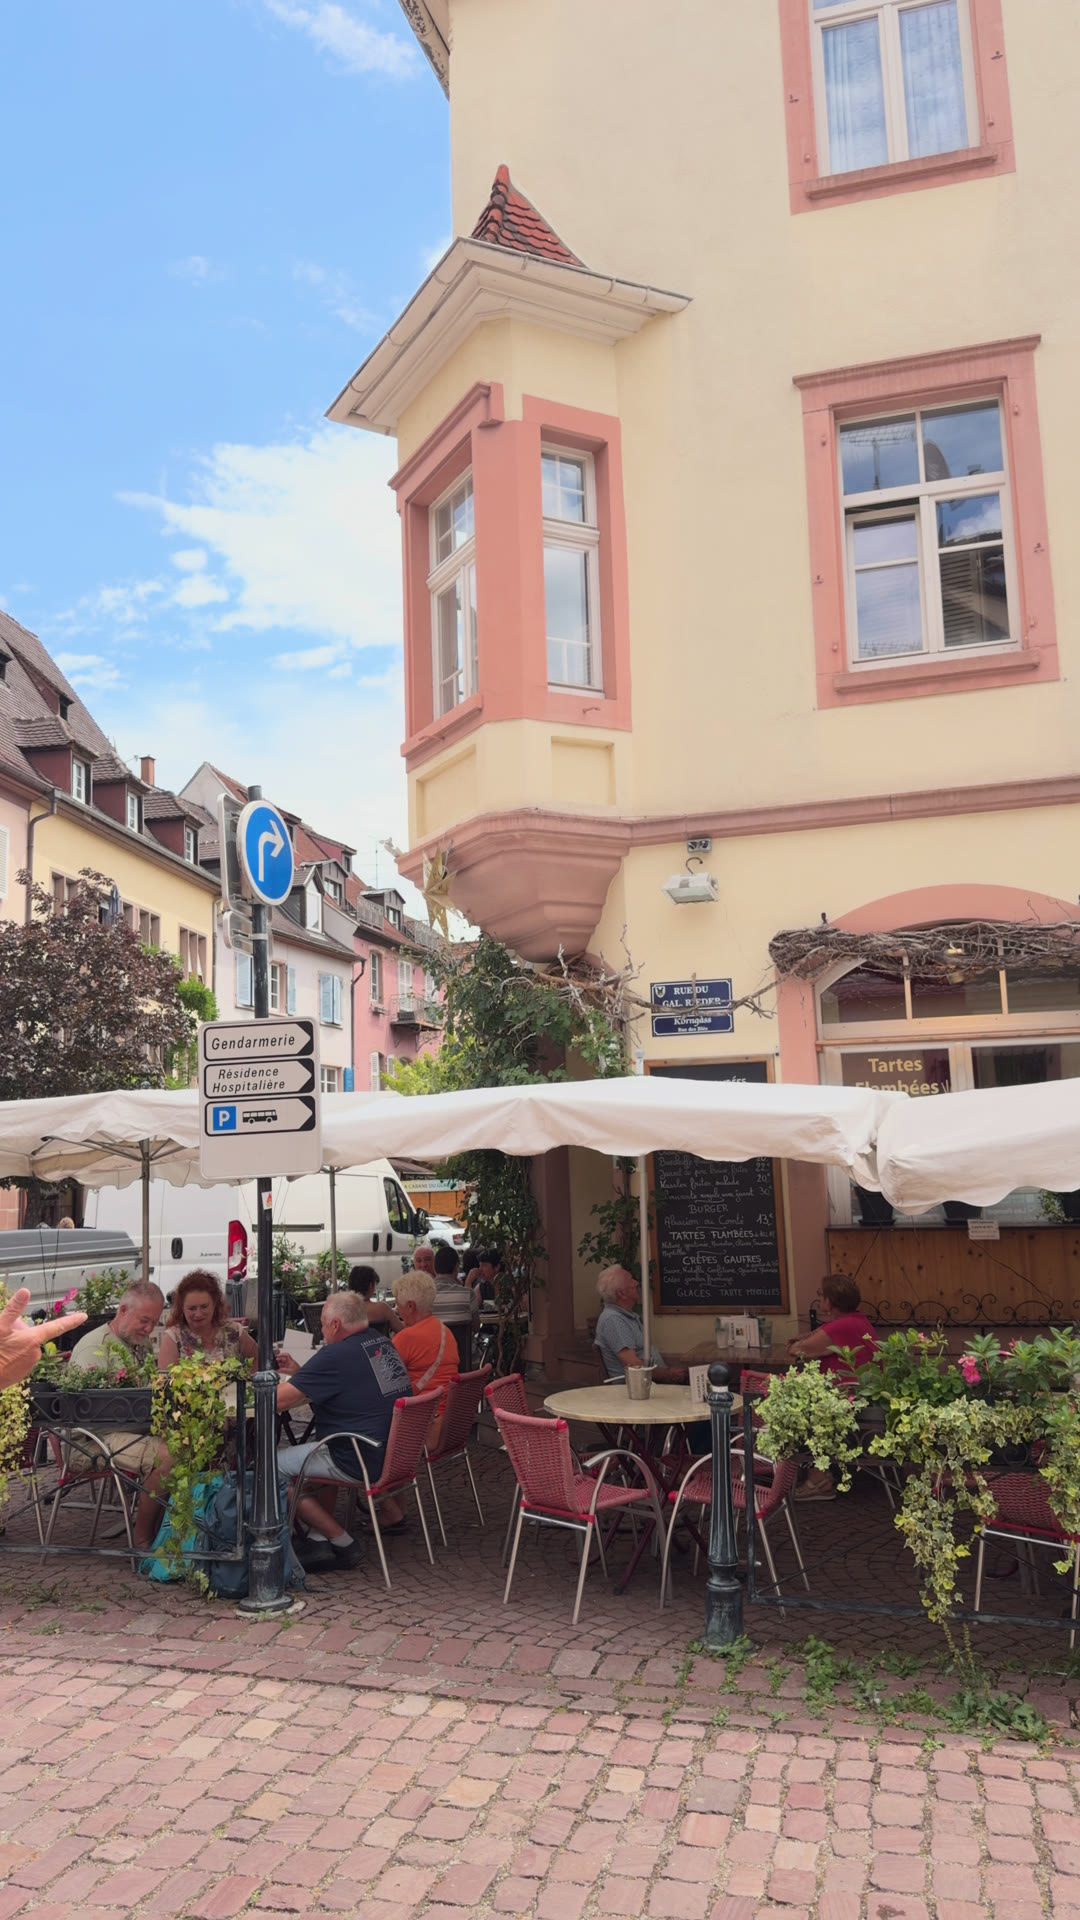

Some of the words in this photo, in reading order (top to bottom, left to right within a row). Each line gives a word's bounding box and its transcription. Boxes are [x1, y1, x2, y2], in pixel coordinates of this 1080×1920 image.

[673, 986, 693, 995] RUE
[695, 985, 709, 994] DU
[685, 997, 722, 1007] REDER
[211, 1034, 295, 1050] Gendarmerie
[868, 1058, 923, 1073] Tartes
[218, 1067, 279, 1080] Résidence
[212, 1079, 285, 1094] Hospitalière
[218, 1110, 231, 1127] P
[688, 1203, 729, 1214] BURGER
[718, 1213, 744, 1226] Comté
[669, 1231, 706, 1240] TARTES
[710, 1227, 754, 1239] FLAMBÉES
[723, 1255, 762, 1265] GAUFRES
[676, 1287, 712, 1298] GLACES
[720, 1288, 745, 1297] TARTE
